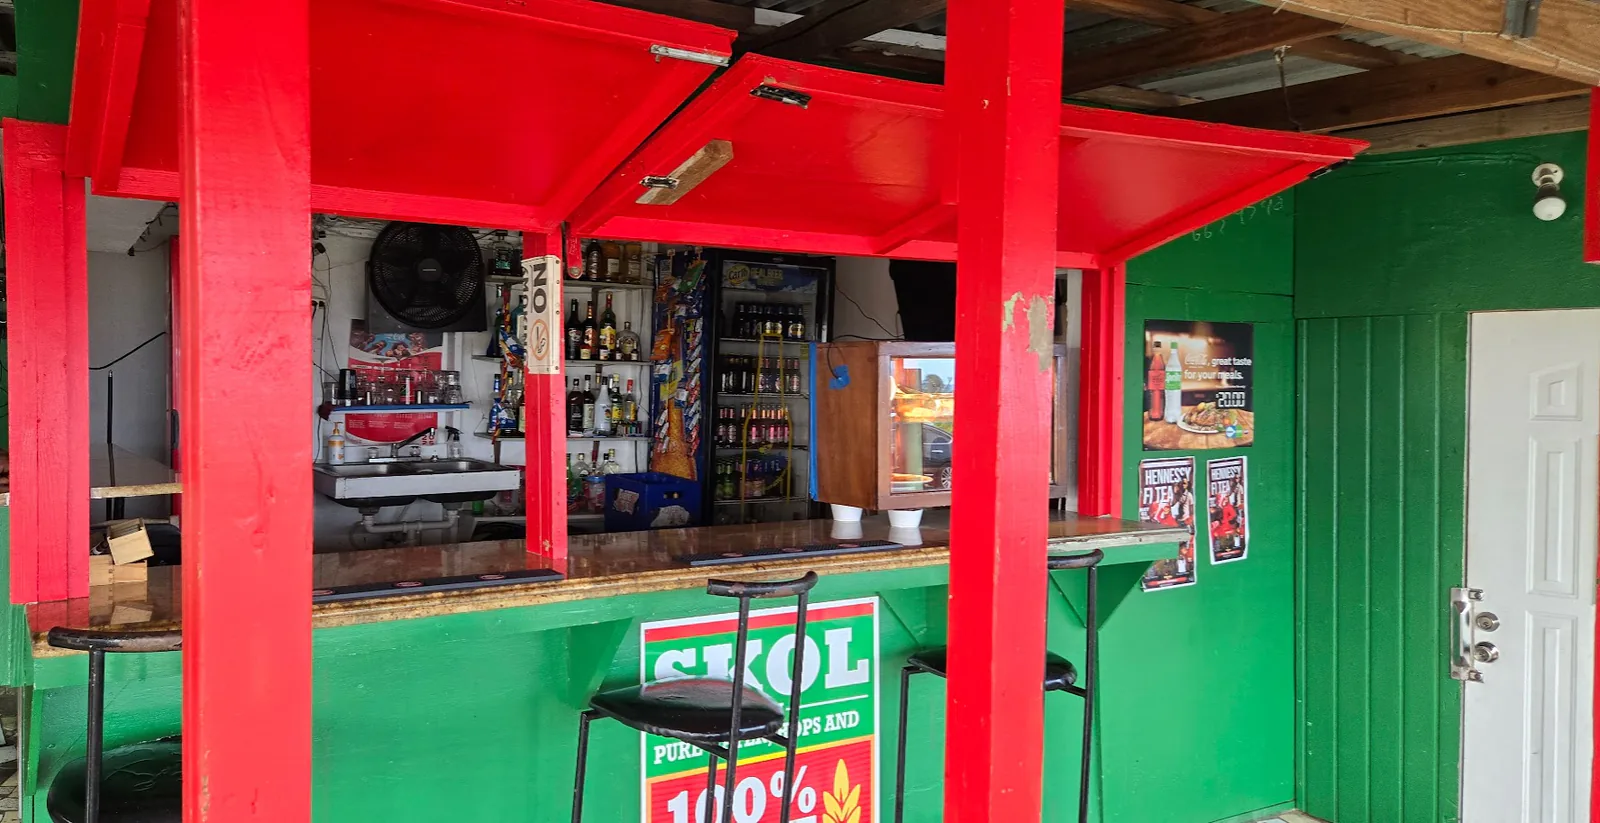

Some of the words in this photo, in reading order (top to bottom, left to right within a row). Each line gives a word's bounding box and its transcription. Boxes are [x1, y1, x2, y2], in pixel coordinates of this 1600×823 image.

[533, 263, 547, 313] NO
[1184, 369, 1196, 379] for
[1197, 371, 1216, 381] your
[1217, 370, 1244, 380] meals.
[1211, 357, 1232, 367] great
[1233, 357, 1252, 366] taste
[1143, 487, 1153, 505] FI
[1155, 485, 1174, 504] TEA
[655, 627, 870, 696] SKOL
[654, 741, 703, 765] PURE
[824, 710, 860, 732] AND
[667, 765, 817, 823] 100%
